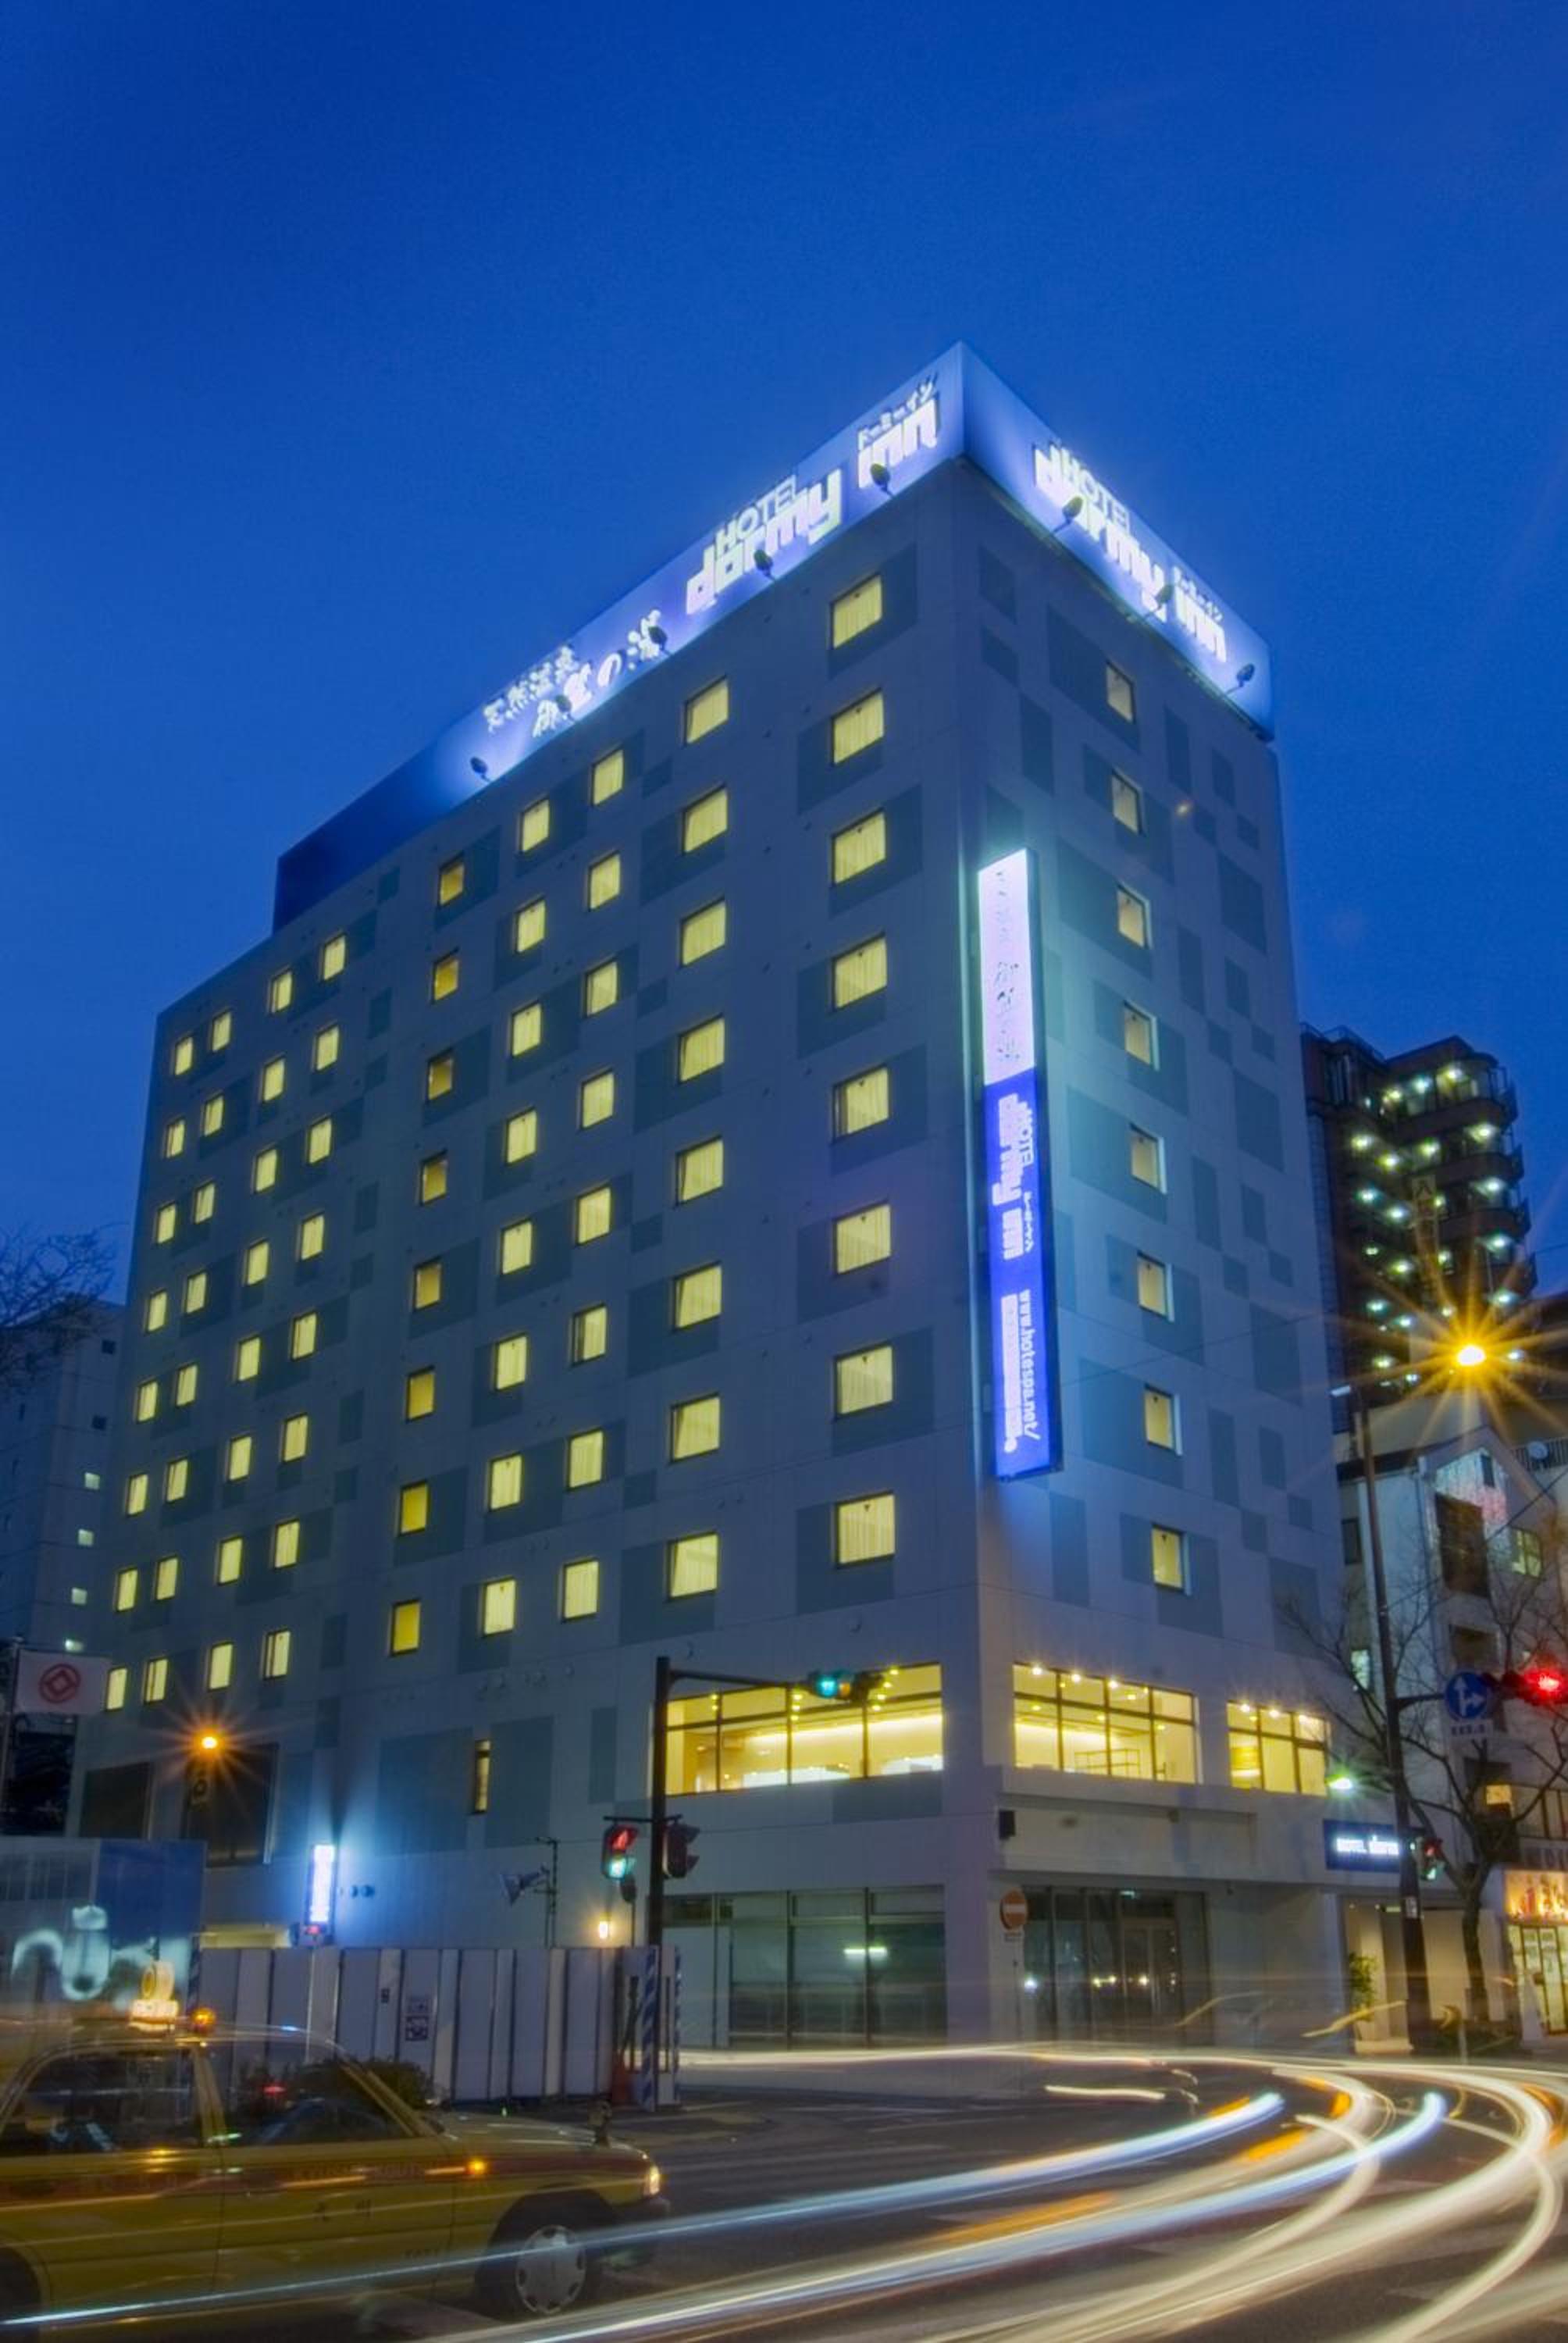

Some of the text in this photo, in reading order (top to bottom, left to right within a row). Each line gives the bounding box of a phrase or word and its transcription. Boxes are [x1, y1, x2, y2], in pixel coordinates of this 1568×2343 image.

[686, 398, 938, 615] dormy inn
[715, 474, 796, 554] HOTEL
[1174, 585, 1228, 663] inn
